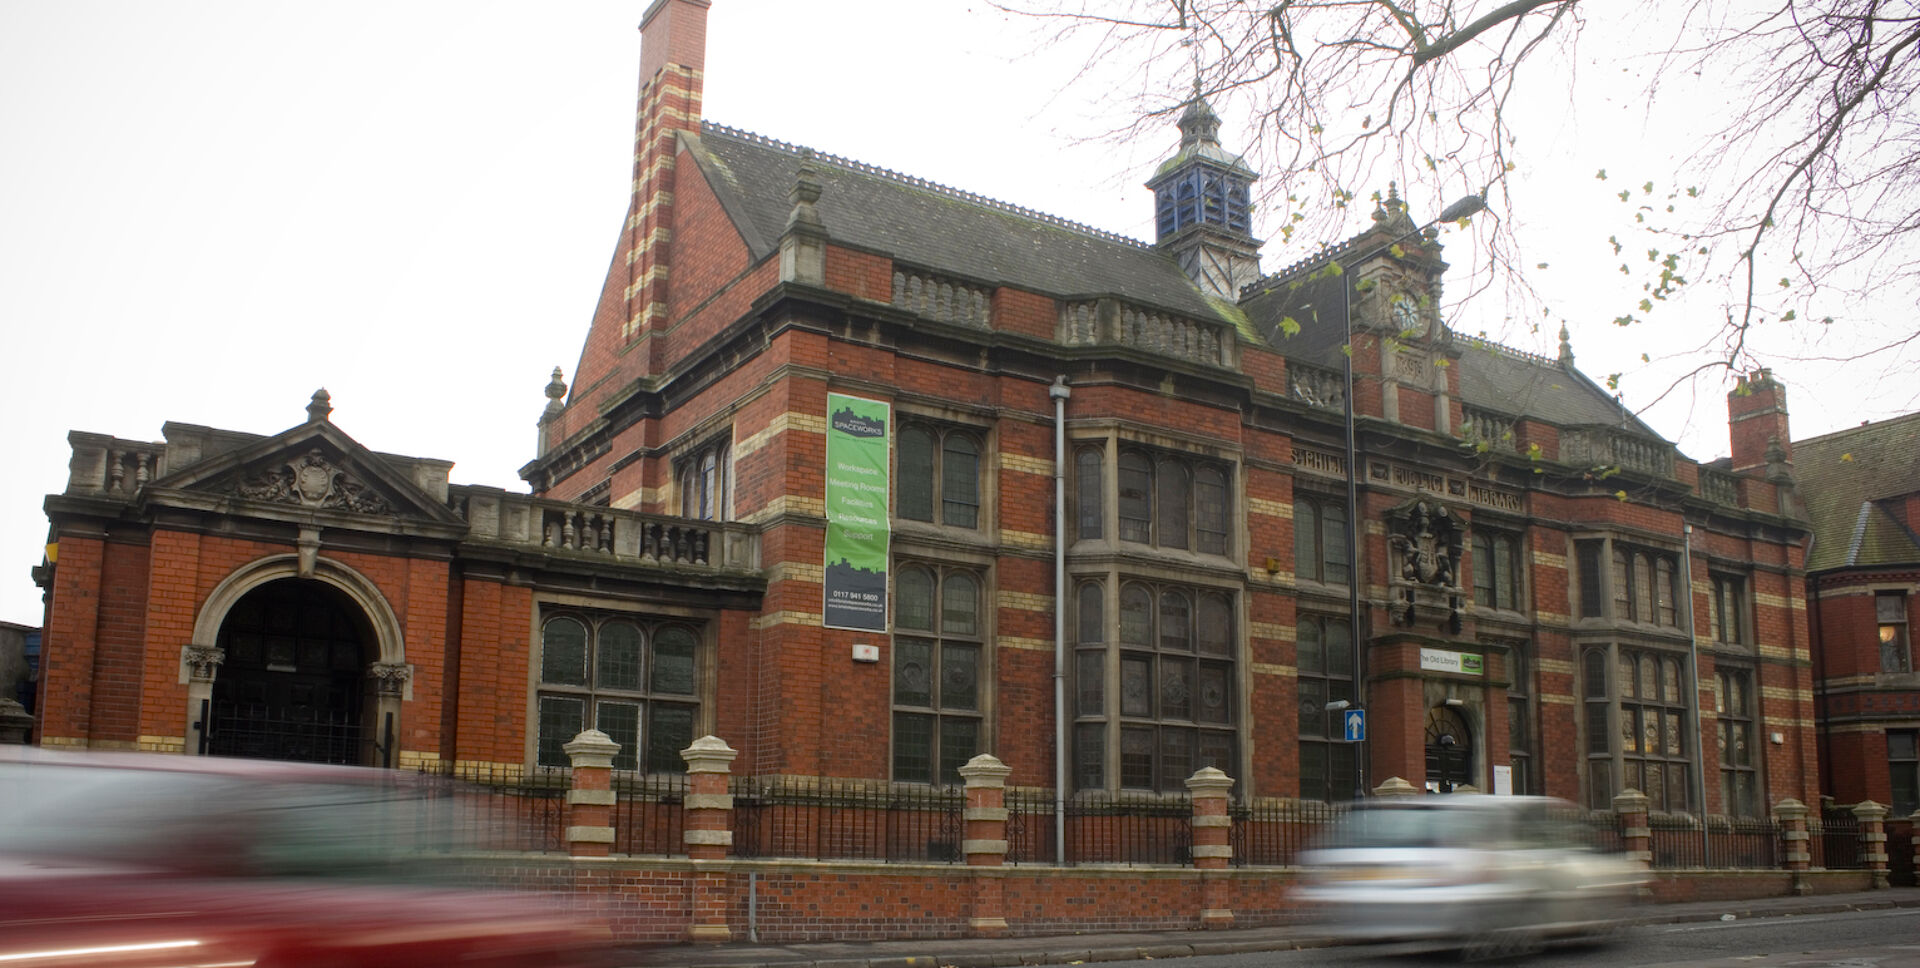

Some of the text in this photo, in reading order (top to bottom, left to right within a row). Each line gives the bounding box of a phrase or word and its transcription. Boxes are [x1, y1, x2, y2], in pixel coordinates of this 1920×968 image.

[834, 421, 882, 435] SPACEWORKS
[838, 462, 878, 475] Workspace
[829, 477, 885, 493] Meeting Rooms
[1396, 467, 1443, 492] PUBLIC
[1469, 483, 1523, 512] LIBRARY
[841, 496, 873, 508] Facilities
[843, 528, 873, 541] Support
[833, 590, 849, 598] 0117
[850, 592, 861, 600] 941
[1430, 655, 1440, 664] Old
[1440, 656, 1458, 667] Library
